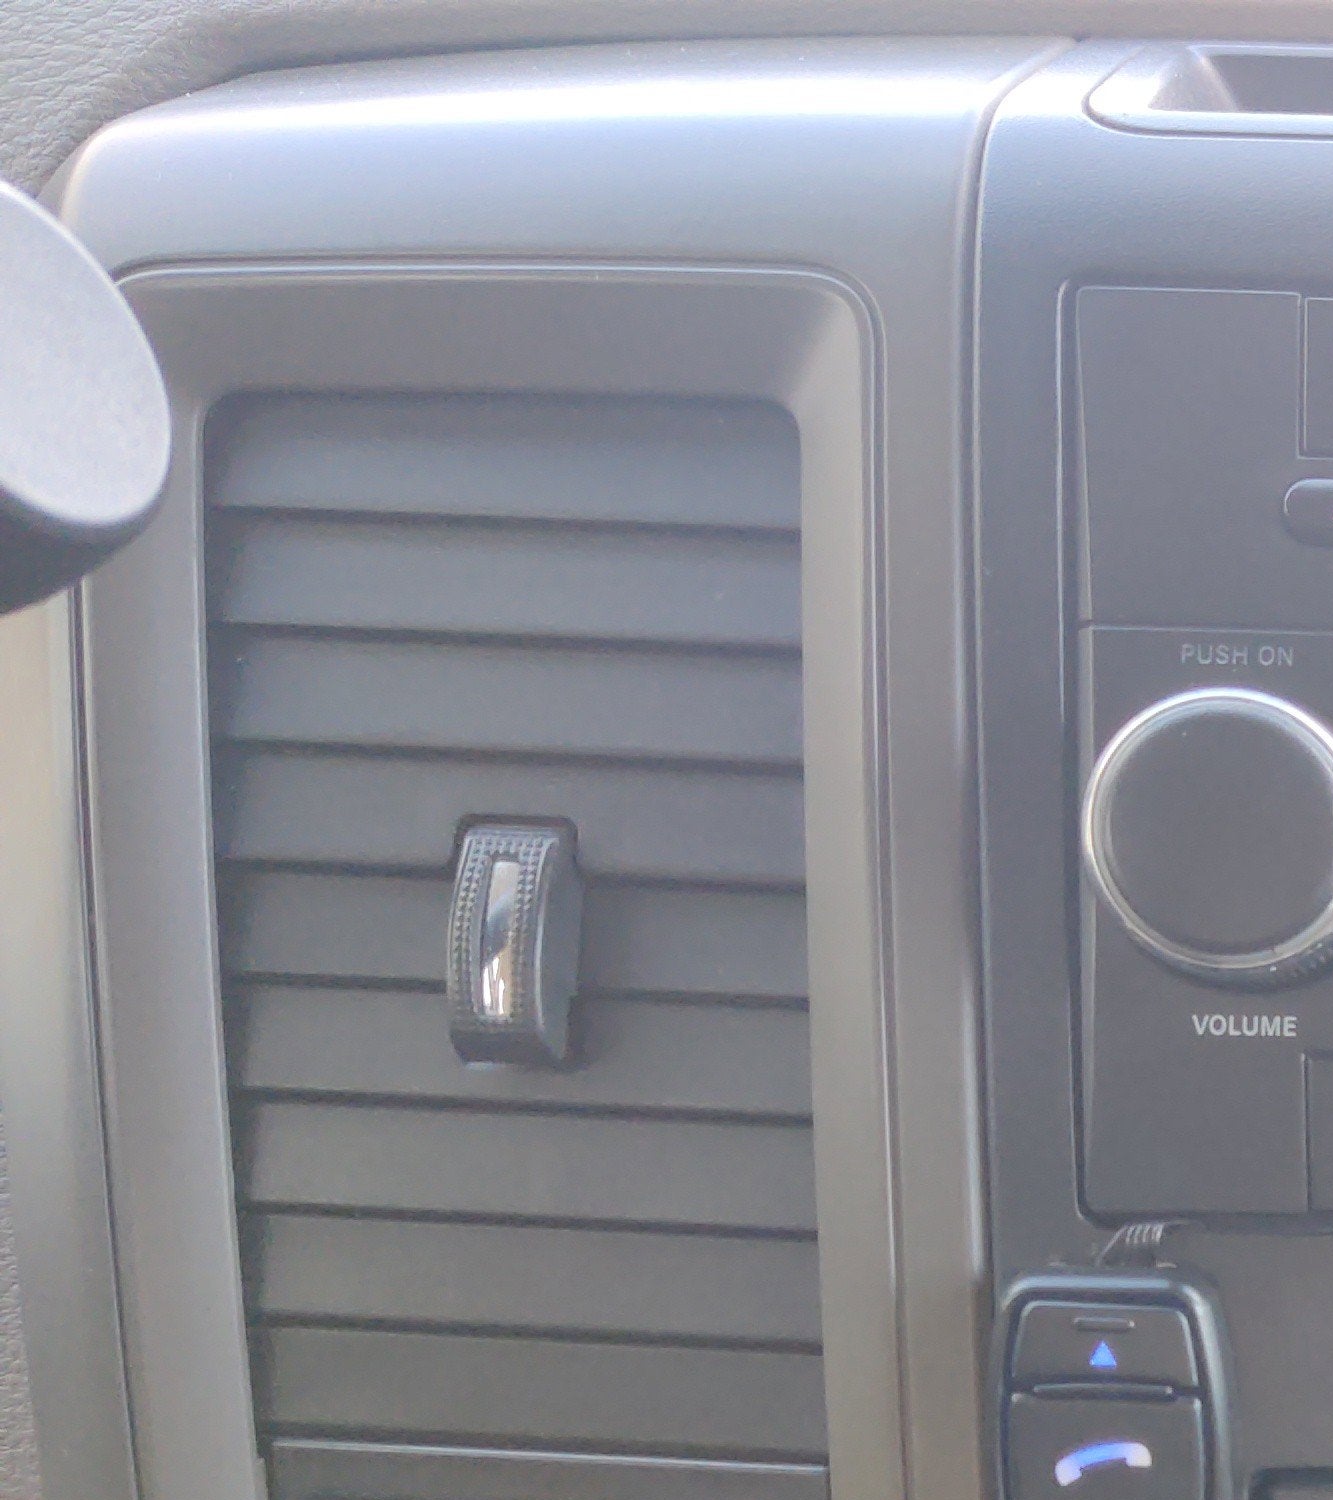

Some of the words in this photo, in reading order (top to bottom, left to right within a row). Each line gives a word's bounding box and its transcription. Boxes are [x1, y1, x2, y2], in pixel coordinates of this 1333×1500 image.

[1181, 643, 1248, 666] PUSH
[1258, 645, 1293, 667] ON
[1191, 1014, 1298, 1037] VOLUME
